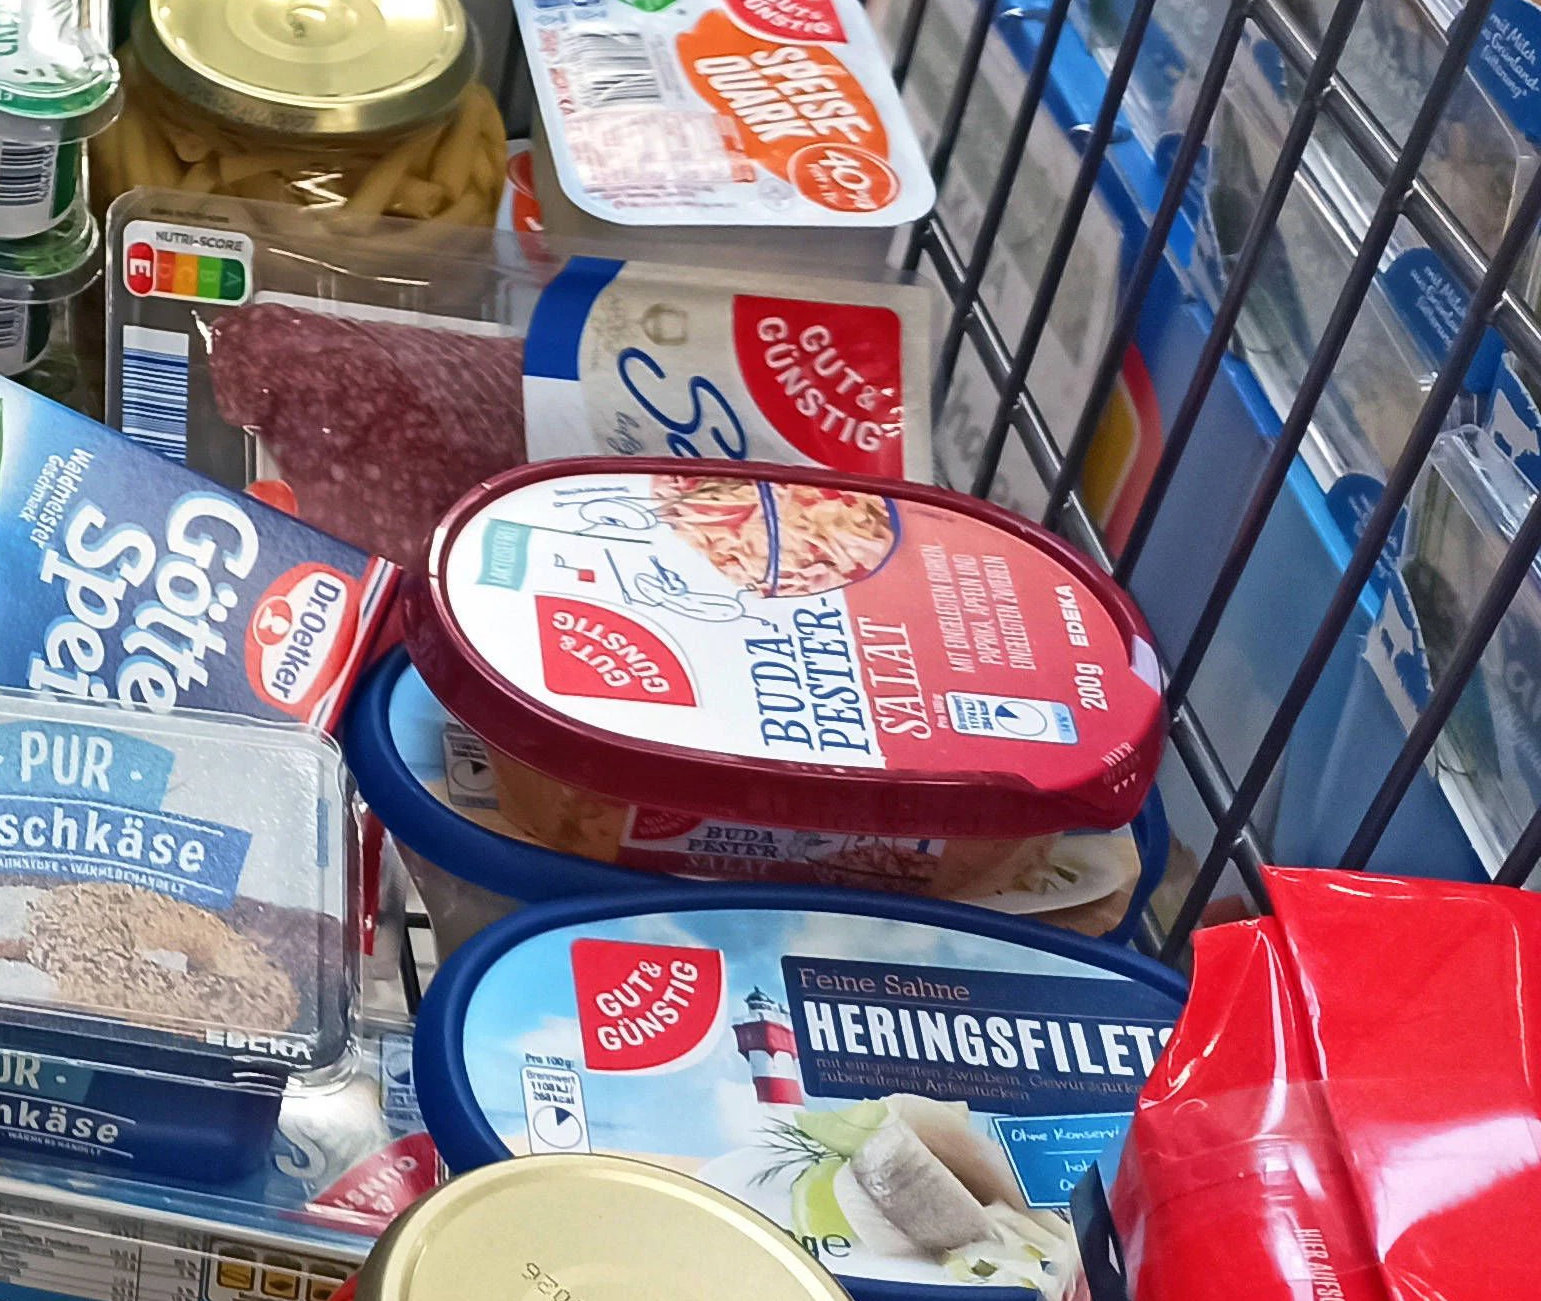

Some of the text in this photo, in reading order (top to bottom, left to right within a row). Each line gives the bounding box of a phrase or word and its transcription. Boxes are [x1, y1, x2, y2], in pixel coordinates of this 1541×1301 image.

[696, 54, 817, 143] QUARK
[156, 231, 244, 251] NUTRI-SCORE
[757, 316, 883, 452] GÜNSTIG
[19, 454, 60, 523] Geschmack
[29, 447, 95, 550] Waldmeister
[931, 585, 970, 650] EINGELEGTEN
[993, 604, 1037, 671] EINGELEGTEN
[1054, 585, 1090, 647] EDEKA
[551, 609, 672, 694] GÜNSTIG
[794, 596, 871, 755] PESTER-
[858, 617, 932, 740] SALAT
[945, 651, 975, 673] MIT
[19, 731, 114, 793] PUR
[597, 959, 699, 1051] GÜNSTIG
[798, 968, 971, 1002] Feine Sahne
[526, 1069, 577, 1085] Brennwert
[1011, 1128, 1048, 1142] Ohne
[1294, 1228, 1330, 1259] HIER
